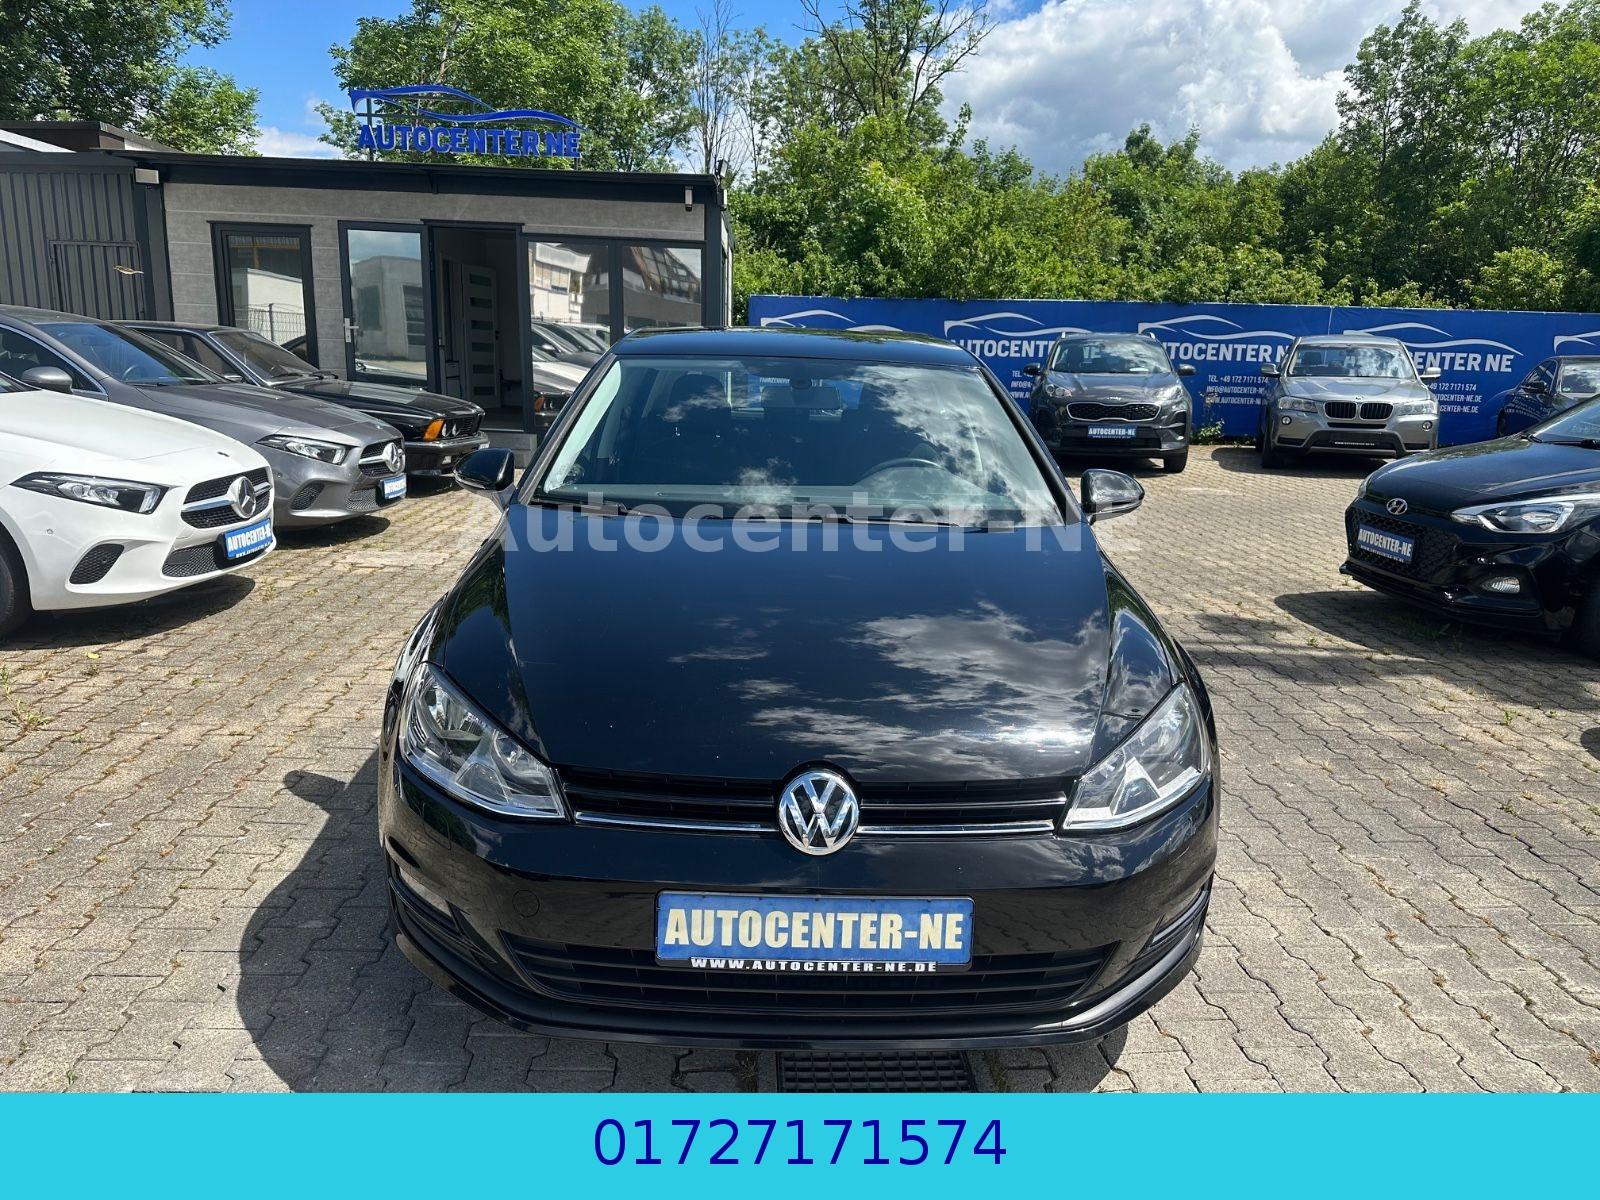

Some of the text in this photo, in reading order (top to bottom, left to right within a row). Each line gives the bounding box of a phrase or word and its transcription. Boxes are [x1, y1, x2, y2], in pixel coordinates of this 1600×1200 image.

[358, 124, 582, 158] AUTOCENTER NE
[1484, 353, 1514, 373] NE
[1232, 375, 1242, 383] 172
[1243, 376, 1257, 384] 7171
[1438, 383, 1450, 391] 172
[1450, 383, 1464, 391] 7171
[1465, 383, 1477, 392] 574
[1358, 528, 1412, 557] AUTOCENTER-NE
[664, 908, 963, 950] AUTOCENTER-NE
[690, 957, 937, 973] WWW.AUTOCENTER-NE.DE
